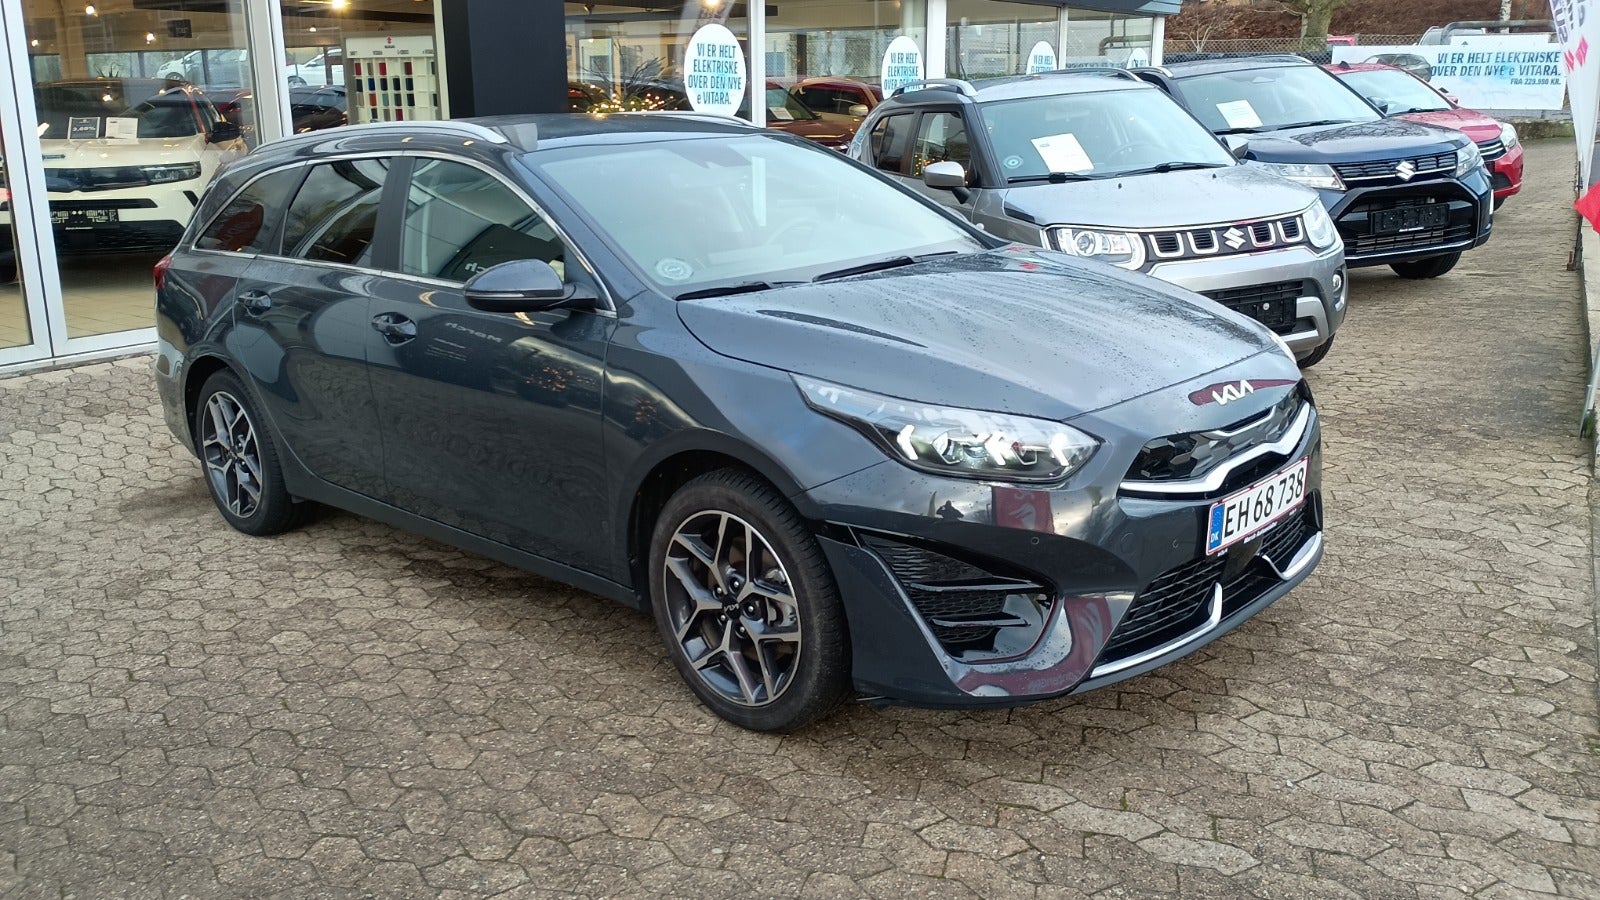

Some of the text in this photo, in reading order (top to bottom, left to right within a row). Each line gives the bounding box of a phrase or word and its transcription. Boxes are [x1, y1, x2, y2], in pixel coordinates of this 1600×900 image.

[697, 43, 736, 58] VI ER HELT
[890, 52, 918, 64] VI ER HELT
[1437, 51, 1561, 64] VI ER HELT ELEKTRISKE
[693, 59, 738, 74] ELEKTRISKE
[887, 66, 919, 77] ELEKTRISKE
[1430, 64, 1561, 77] OVER DEN NYE e VITARA.
[688, 74, 742, 90] OVER DEN NYE
[1510, 78, 1523, 86] FRA
[696, 92, 732, 105] e VITARA.
[1224, 497, 1251, 539] EH
[1253, 485, 1275, 523] 68
[1278, 467, 1305, 510] 738
